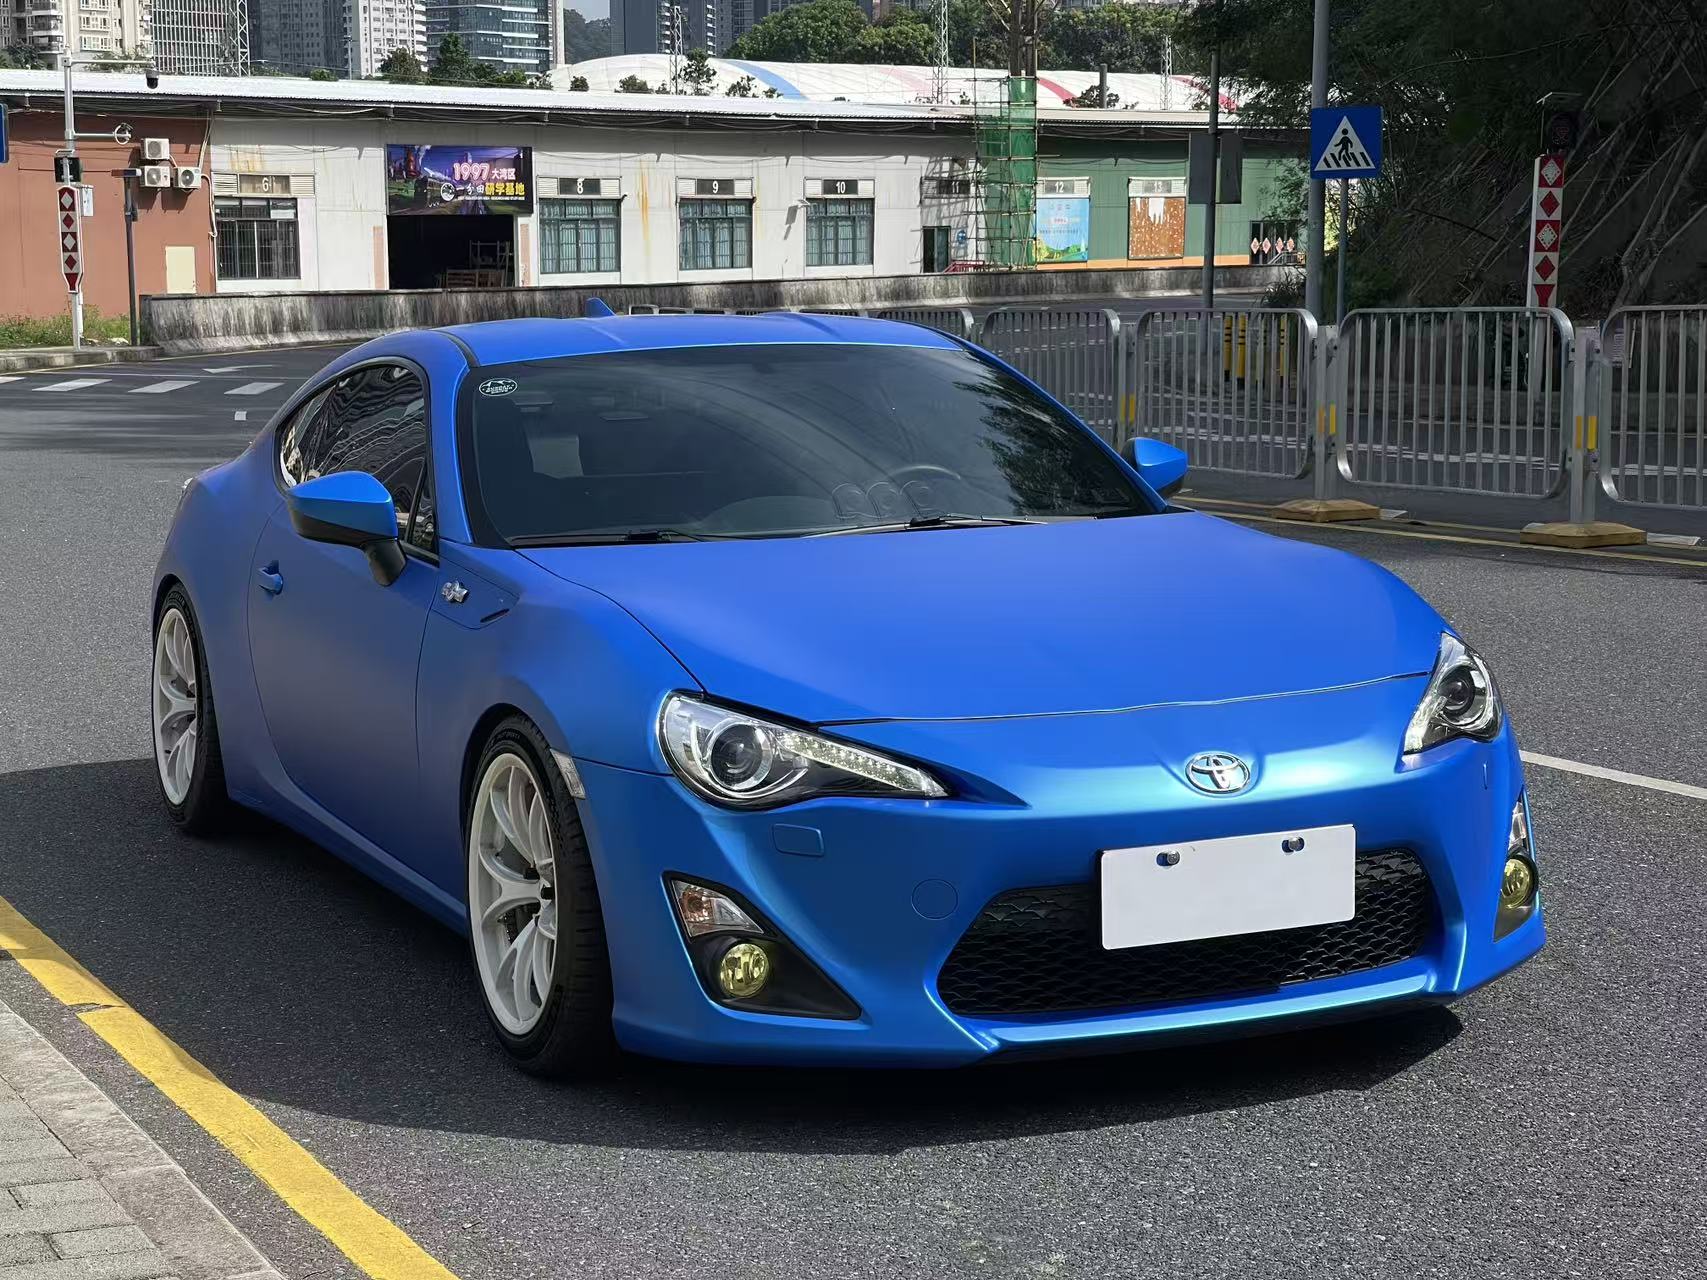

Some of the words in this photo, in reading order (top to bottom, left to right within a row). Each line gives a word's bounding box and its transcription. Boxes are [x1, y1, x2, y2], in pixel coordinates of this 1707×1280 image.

[453, 162, 490, 180] 1997
[491, 168, 516, 180] 大湾区
[577, 180, 584, 194] 8
[712, 180, 719, 194] 9
[835, 181, 846, 194] 10
[951, 181, 960, 193] 11
[1055, 181, 1065, 193] 12
[1153, 181, 1163, 192] 13
